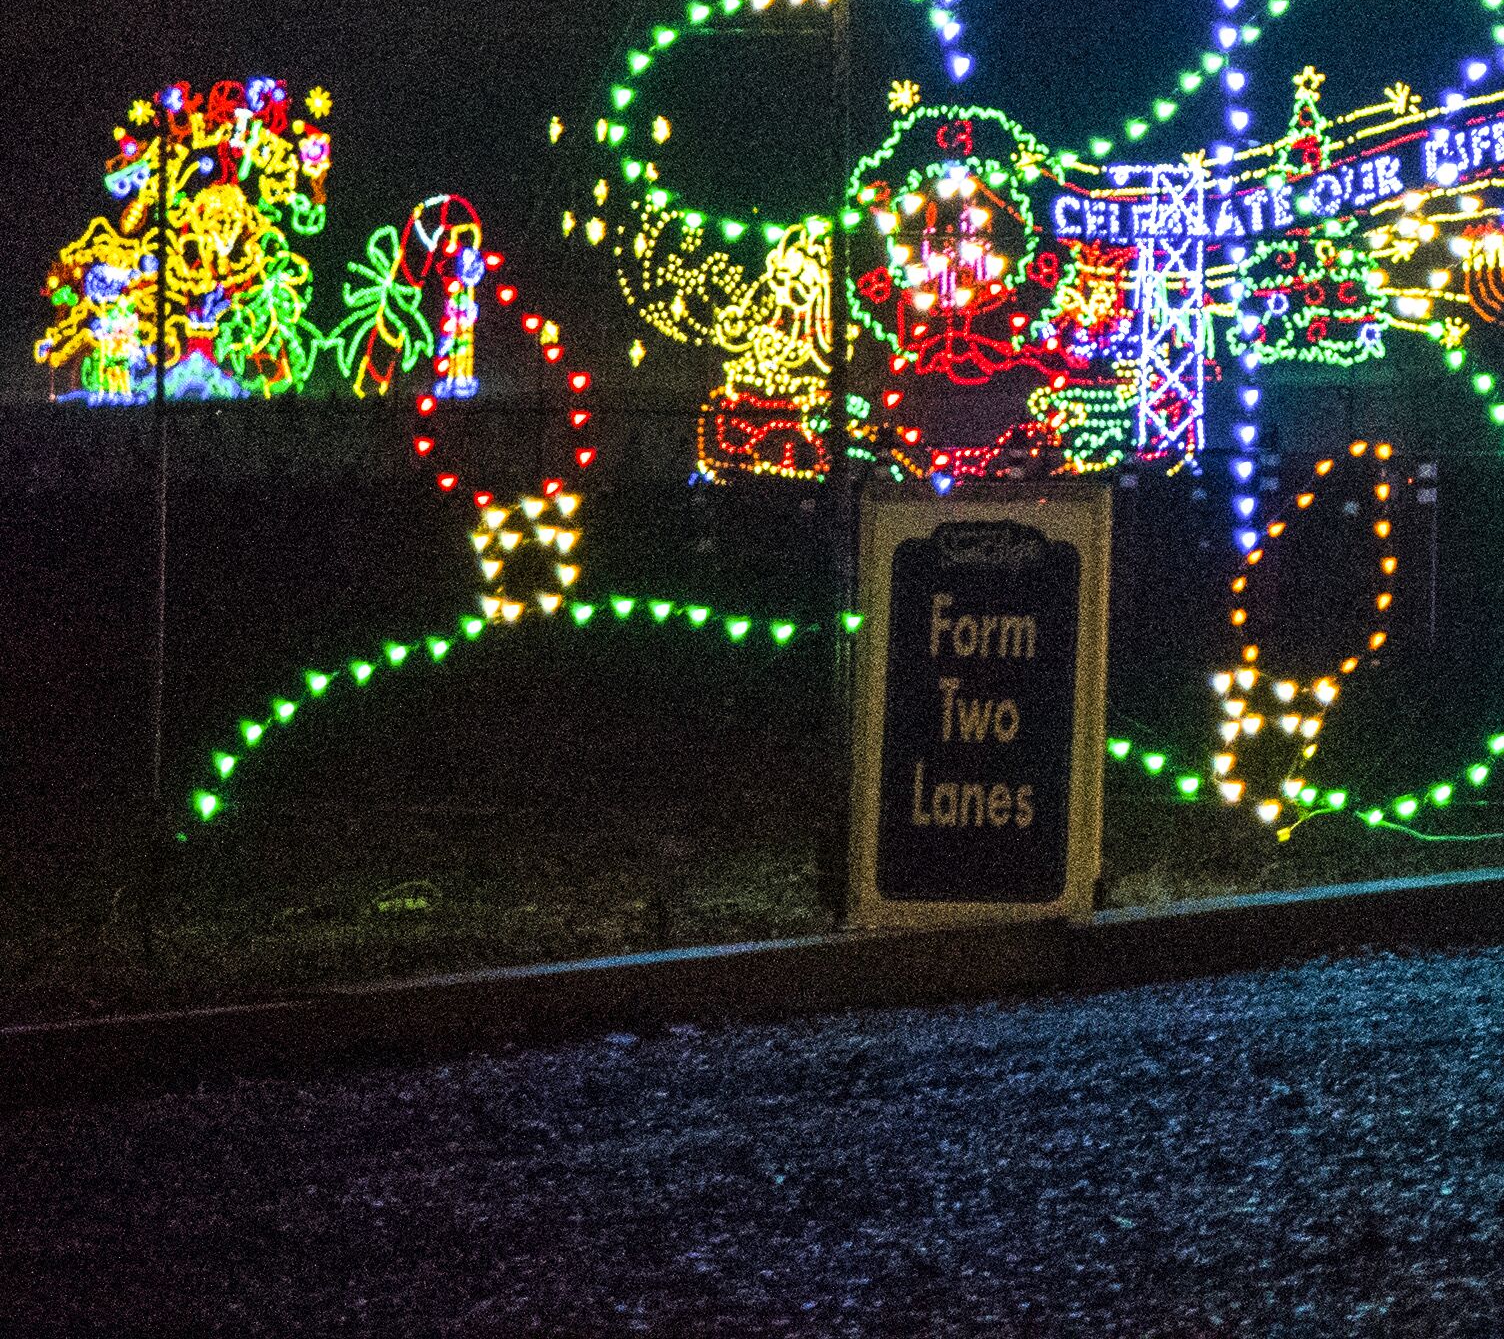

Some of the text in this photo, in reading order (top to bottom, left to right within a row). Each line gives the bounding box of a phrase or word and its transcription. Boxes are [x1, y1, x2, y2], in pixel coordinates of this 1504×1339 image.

[1308, 156, 1403, 215] OUR
[930, 592, 1036, 659] Form
[939, 677, 1020, 743] Two
[912, 759, 1036, 829] Lanes
